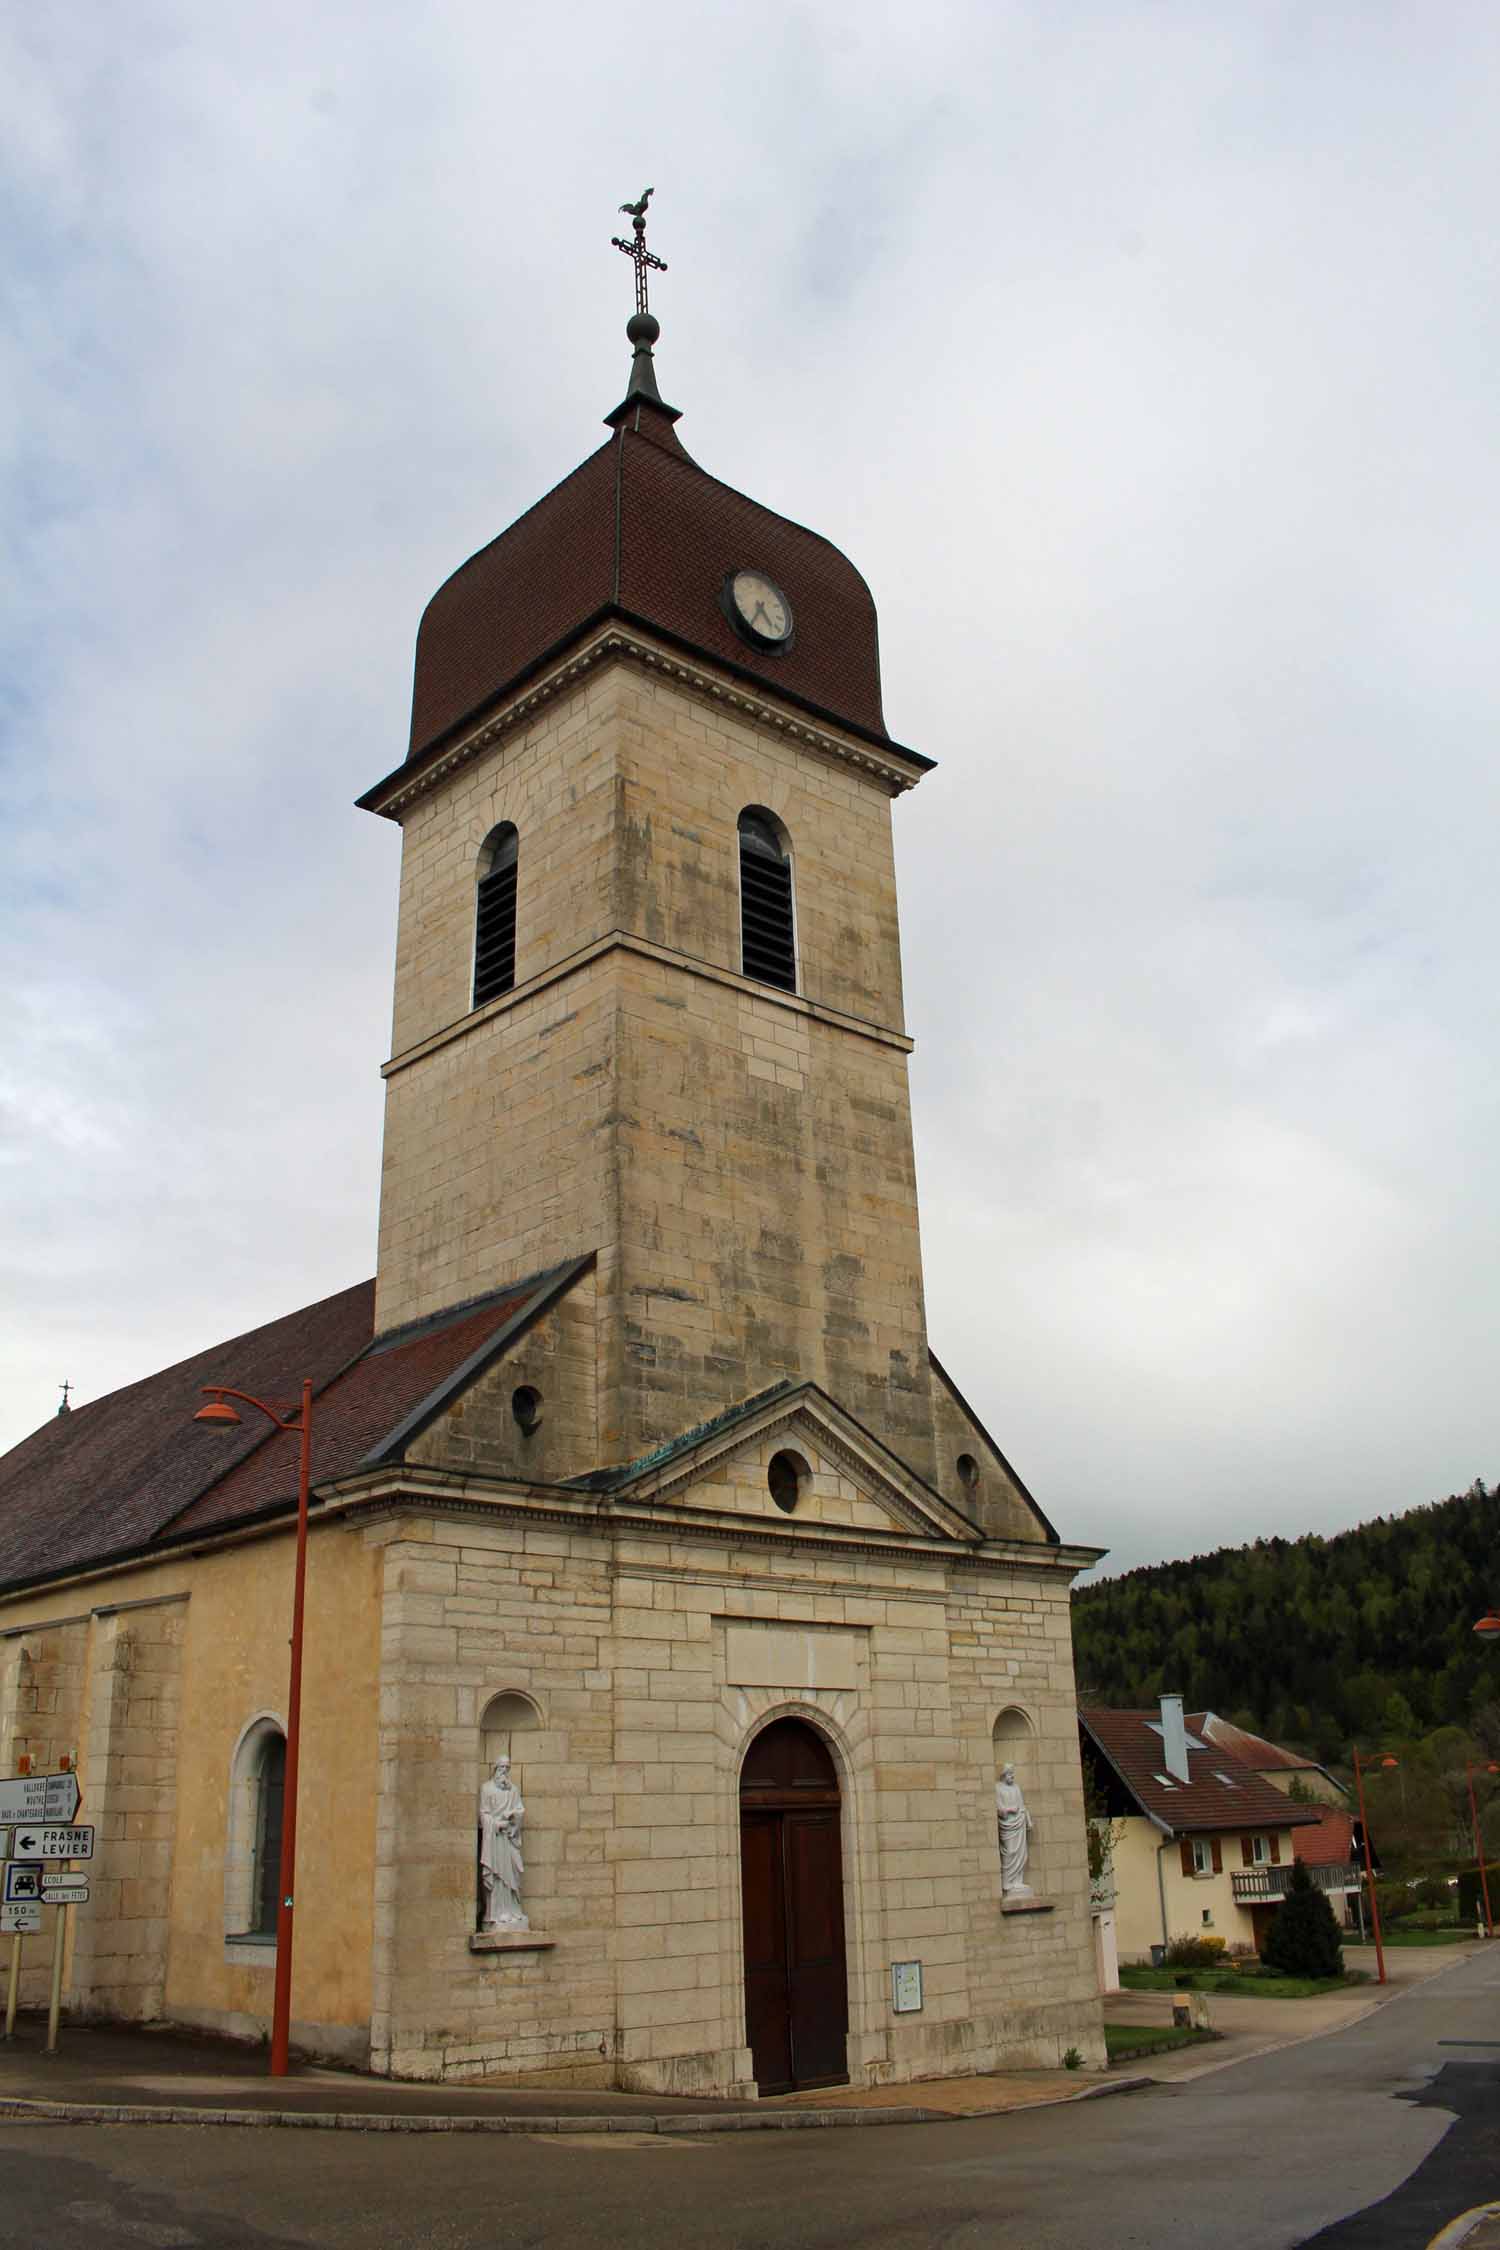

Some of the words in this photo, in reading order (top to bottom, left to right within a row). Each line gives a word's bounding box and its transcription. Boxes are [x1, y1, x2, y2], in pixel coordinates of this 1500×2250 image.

[43, 1831, 89, 1841] FRASNE
[42, 1844, 88, 1855] LEVIER
[9, 1906, 26, 1915] 150
